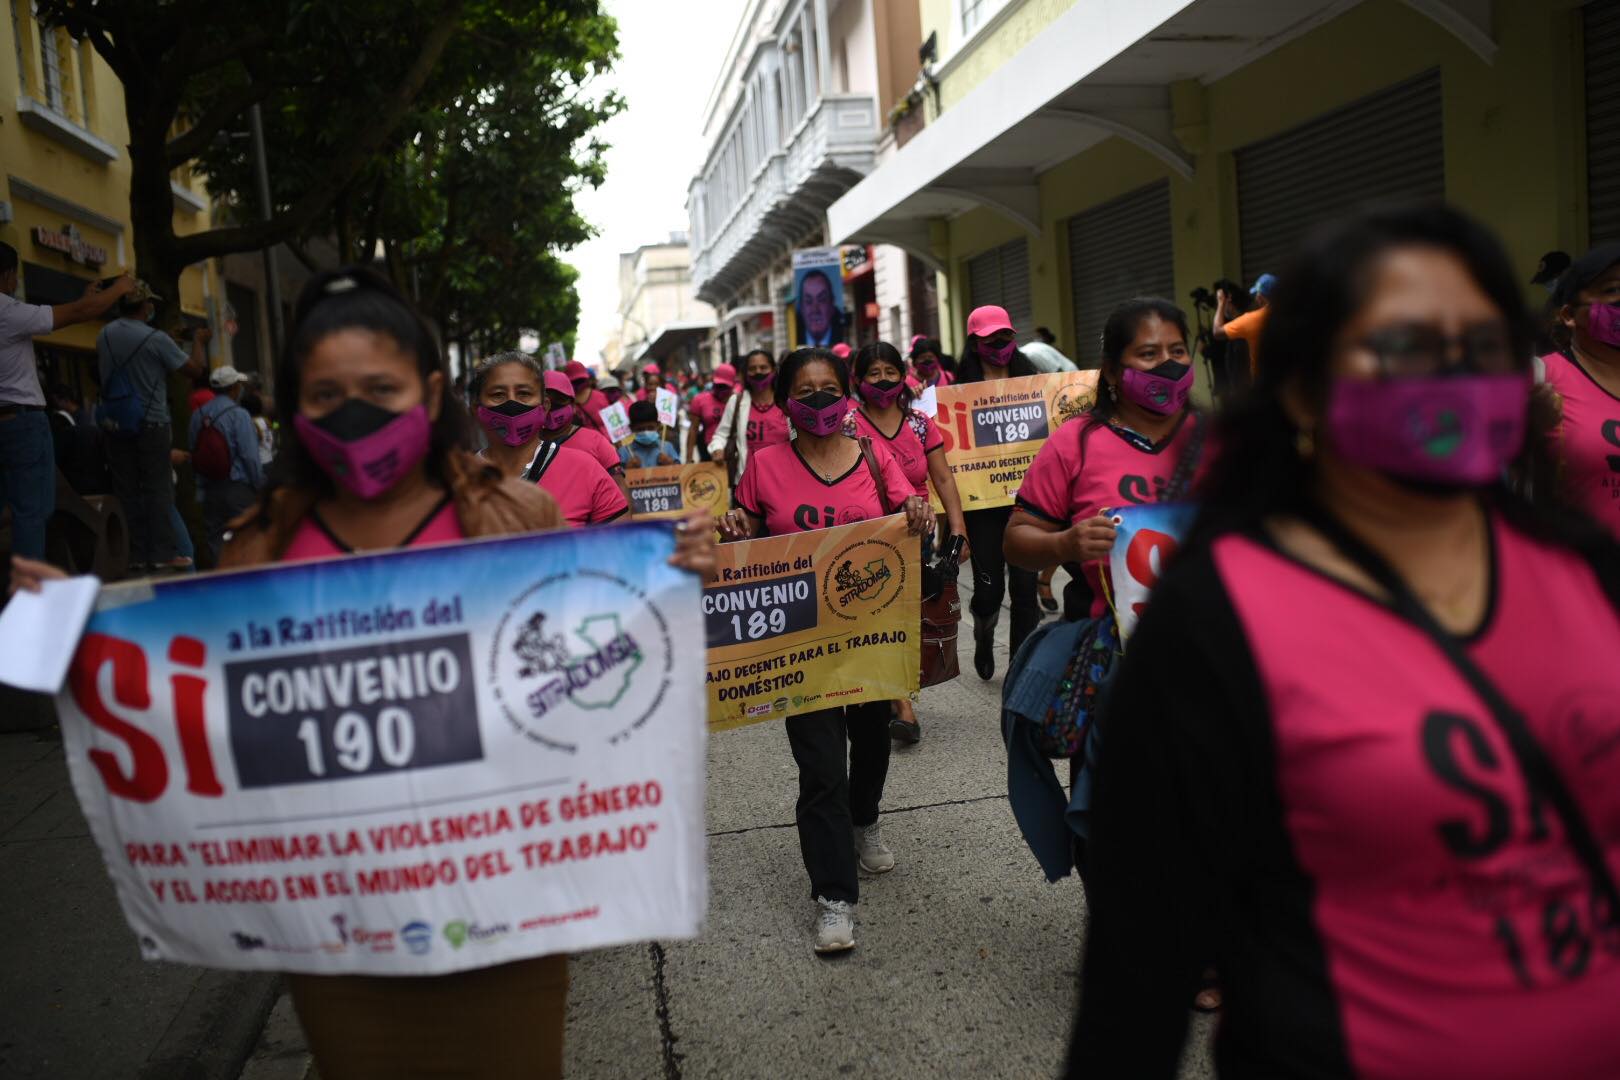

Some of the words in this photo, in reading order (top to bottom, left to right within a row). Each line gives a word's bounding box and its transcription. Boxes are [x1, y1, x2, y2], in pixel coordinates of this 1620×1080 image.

[1031, 390, 1043, 399] del
[747, 420, 765, 441] Si
[977, 405, 1042, 425] CONVENIO
[995, 422, 1029, 443] 189
[961, 460, 997, 472] TRABAJO
[999, 456, 1031, 468] DECENTE
[990, 467, 1026, 484] DOMÉST
[632, 486, 678, 500] CONVENIO
[644, 498, 669, 512] 189
[723, 561, 790, 582] Ratifición
[794, 555, 813, 570] del
[701, 580, 809, 615] CONVENIO
[227, 630, 243, 650] a
[247, 621, 272, 647] la
[277, 604, 415, 645] Ratifición
[422, 593, 464, 625] del
[731, 608, 786, 641] 189
[735, 655, 786, 678] DECENTE
[790, 645, 824, 665] PARA
[827, 642, 842, 654] EL
[845, 630, 907, 650] TRABAJO
[241, 648, 461, 718] CONVENIO
[718, 671, 805, 702] DOMÉSTICO
[69, 631, 225, 805] Si
[298, 706, 415, 777] 190
[125, 841, 188, 867] PARA
[327, 829, 363, 857] LA
[367, 808, 513, 852] VIOLENCIA
[519, 800, 552, 829] DE
[559, 780, 663, 822] GÉNERO
[149, 879, 165, 904] Y
[171, 879, 199, 903] EL
[204, 876, 279, 904] ACOSO
[283, 872, 318, 901] EN
[322, 870, 352, 895] EL
[356, 859, 458, 896] MUNDO
[464, 851, 512, 882] DEL
